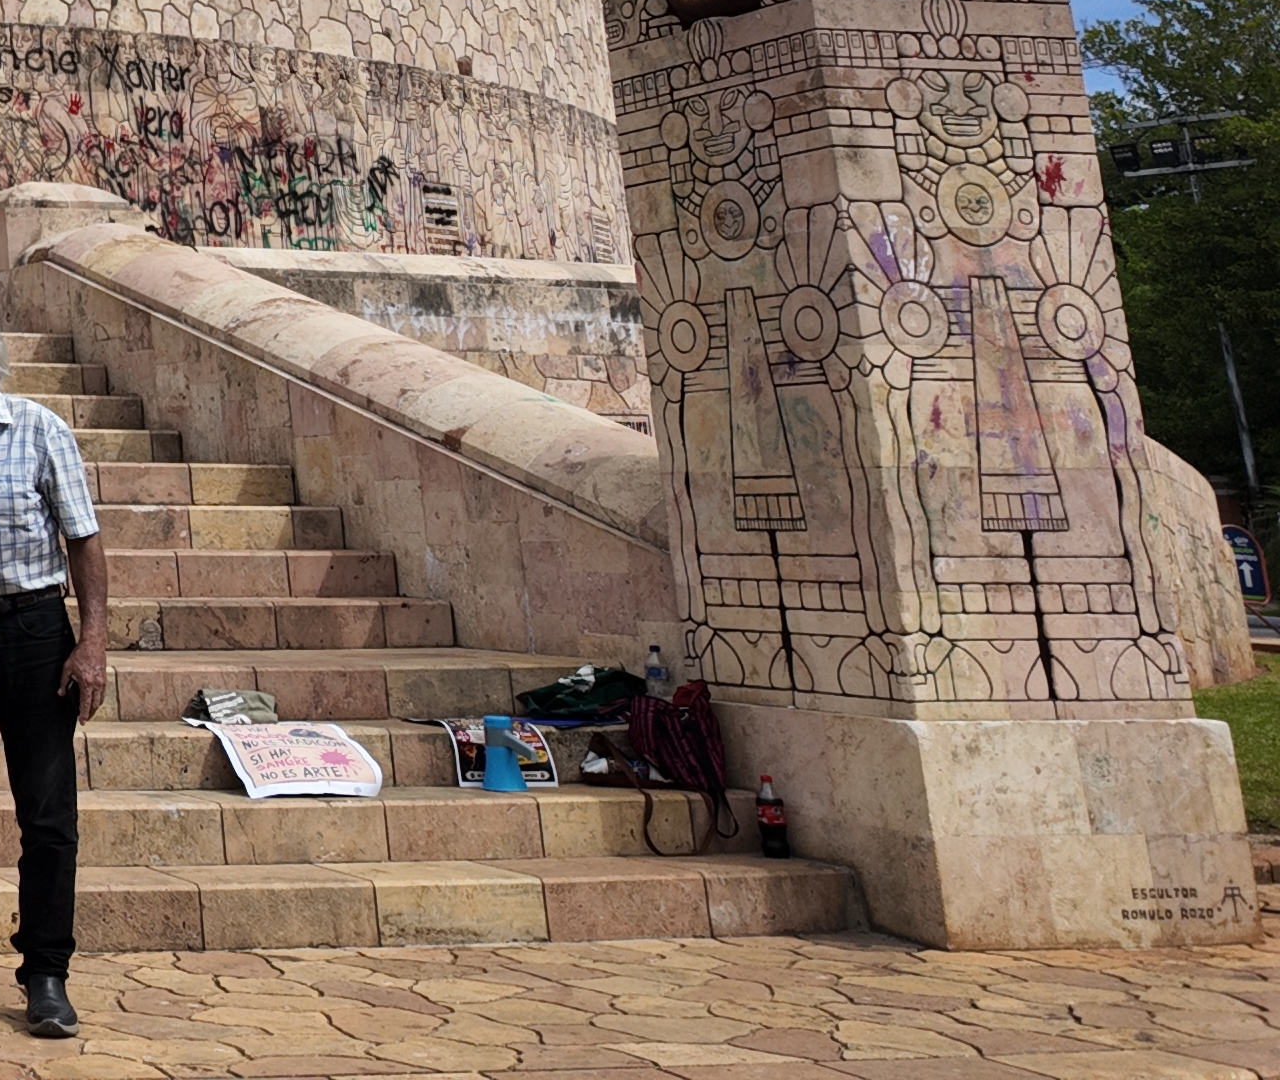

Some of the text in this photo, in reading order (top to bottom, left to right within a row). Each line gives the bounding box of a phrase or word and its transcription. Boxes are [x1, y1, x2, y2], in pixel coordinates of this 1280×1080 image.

[242, 738, 259, 751] NO
[262, 738, 278, 747] ES
[249, 748, 294, 766] SI HAY
[255, 756, 312, 771] SANGRE
[260, 771, 279, 781] NO
[282, 769, 298, 779] ES
[1131, 887, 1198, 900] ESCULTOR
[1121, 907, 1214, 920] ROMULO ROZO
